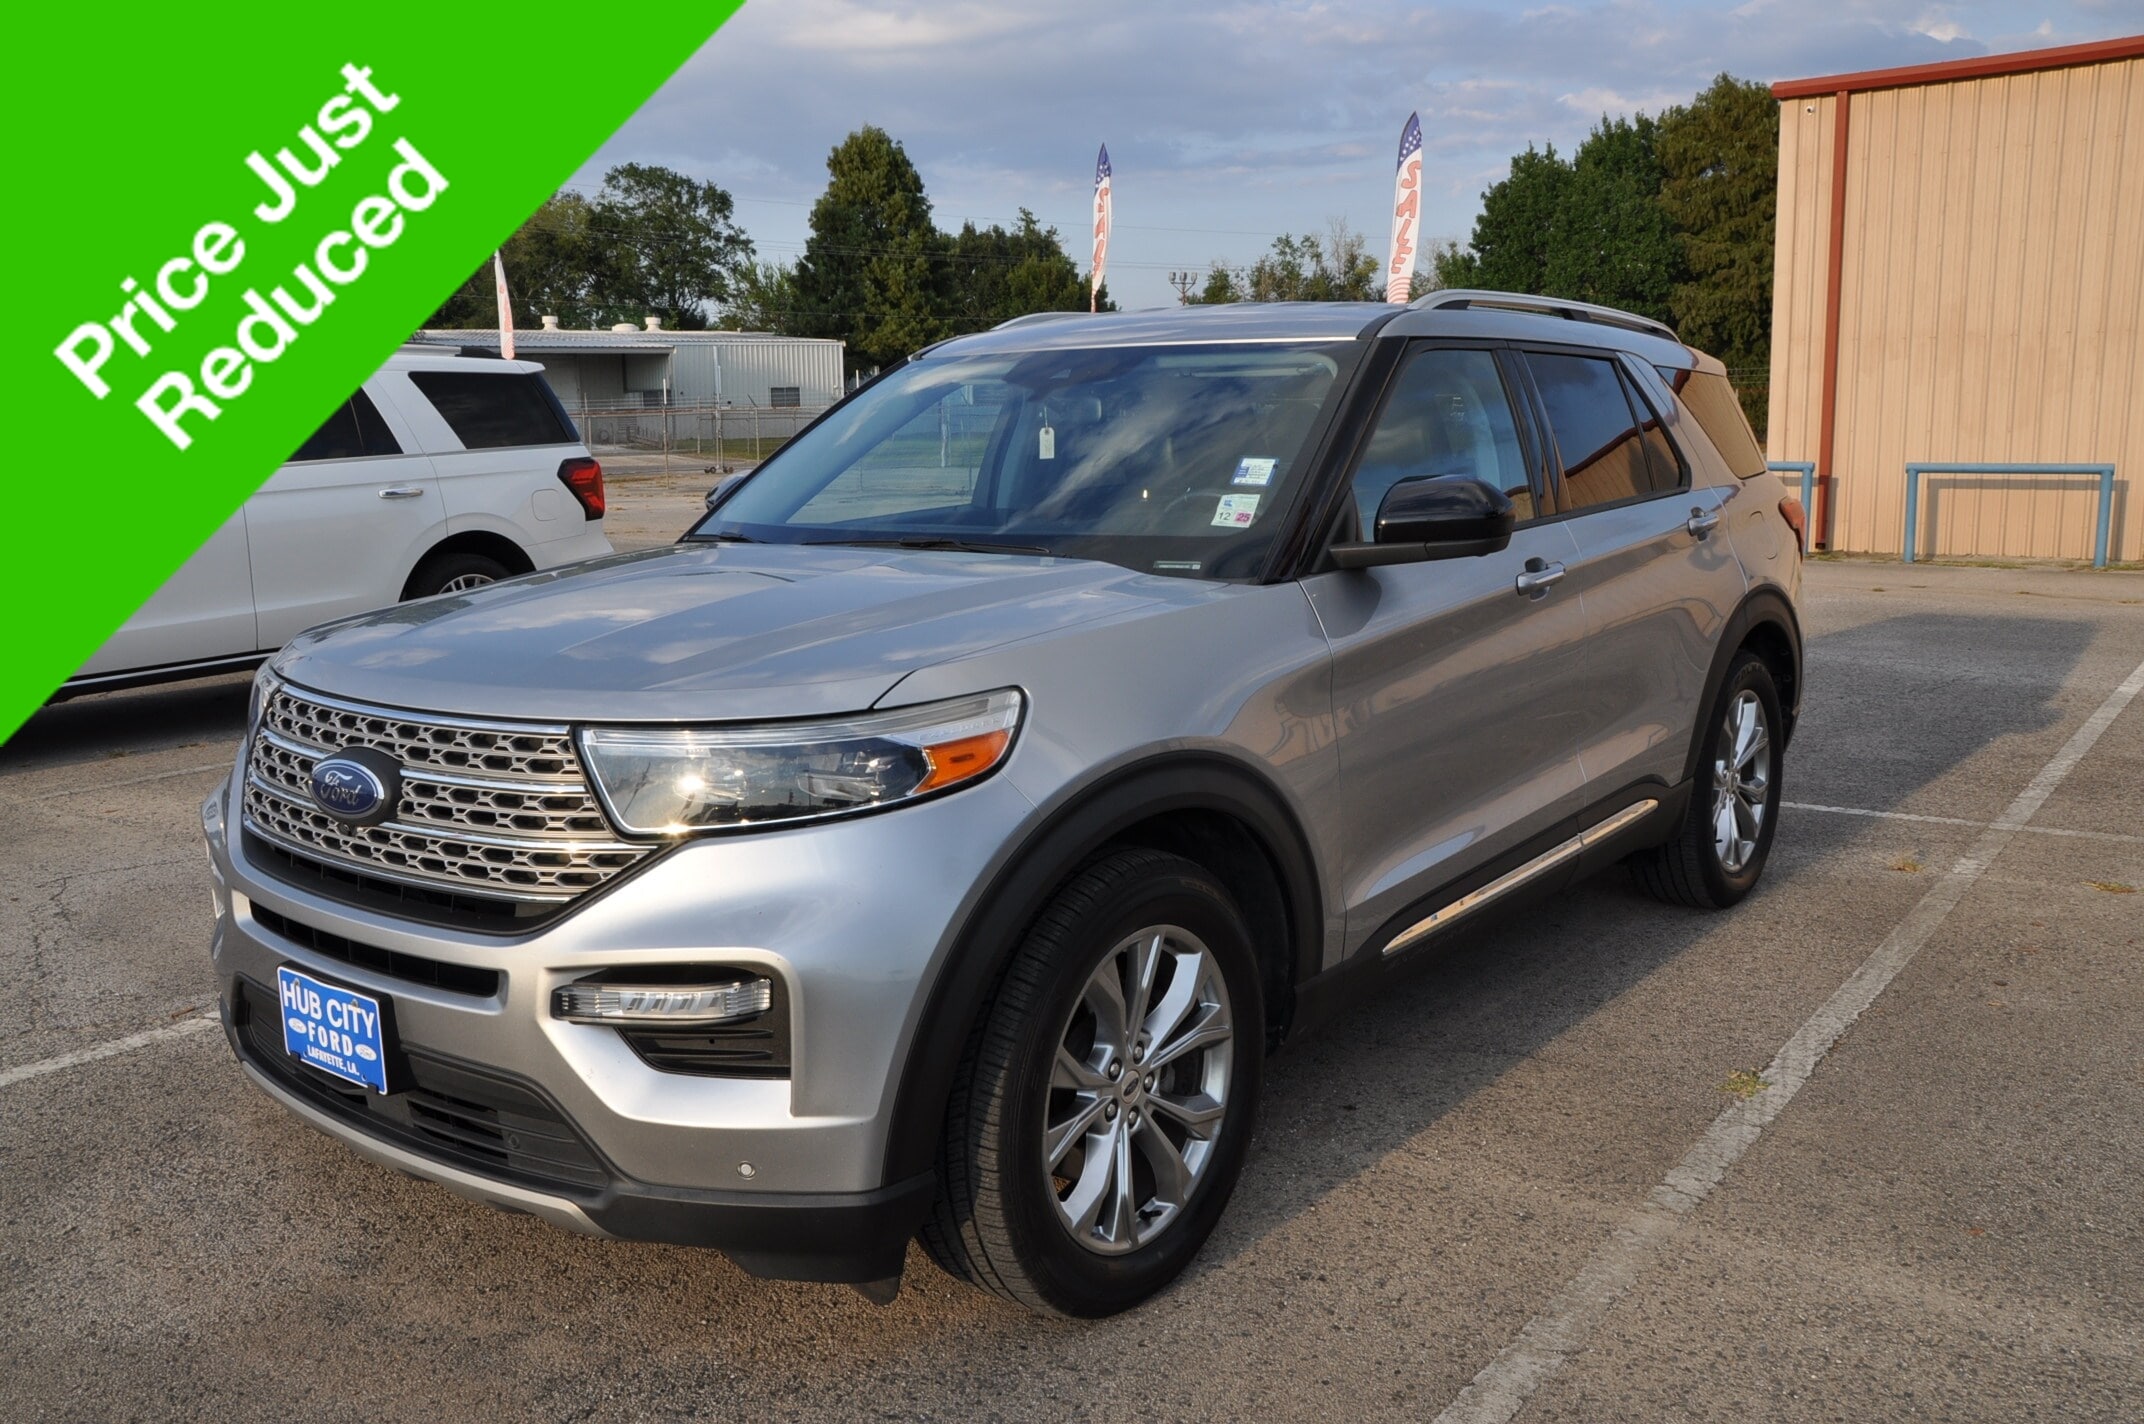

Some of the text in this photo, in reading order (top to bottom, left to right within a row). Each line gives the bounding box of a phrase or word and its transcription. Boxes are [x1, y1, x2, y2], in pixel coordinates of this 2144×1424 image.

[1391, 160, 1422, 274] SALE
[1218, 511, 1251, 522] 12 25
[321, 769, 363, 806] Ford
[281, 980, 375, 1039] HUB CITY
[308, 1020, 353, 1057] FORD
